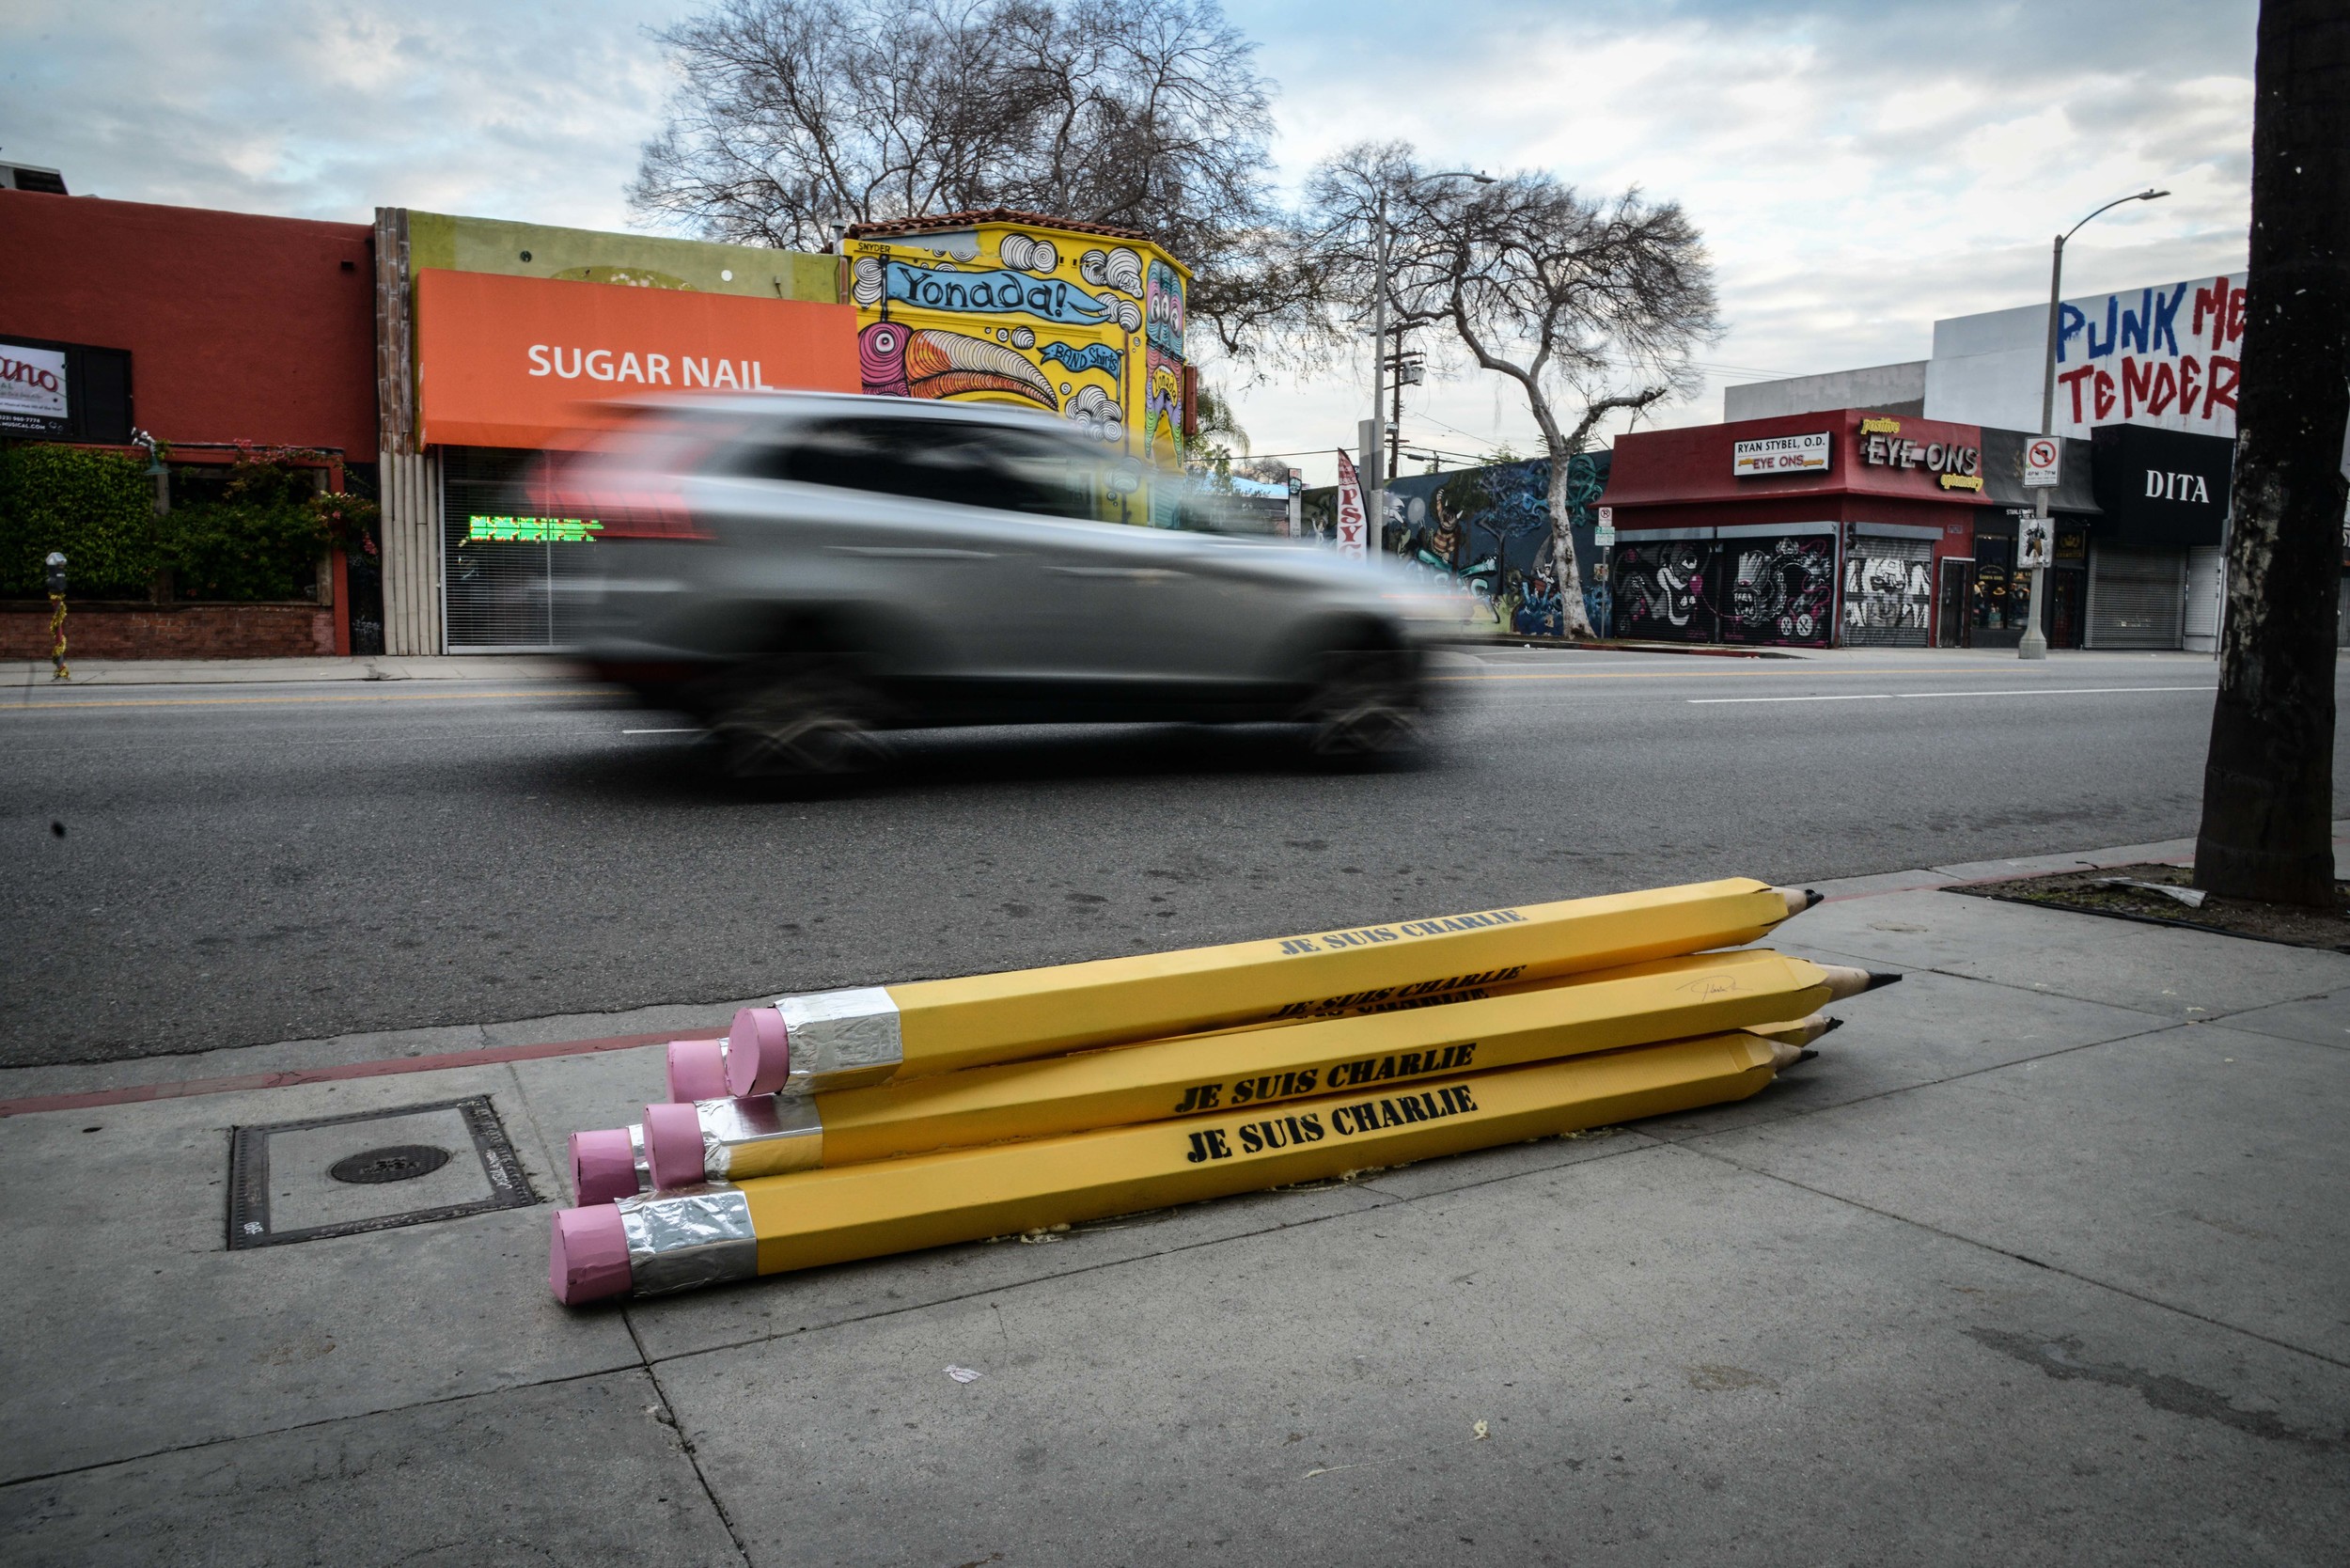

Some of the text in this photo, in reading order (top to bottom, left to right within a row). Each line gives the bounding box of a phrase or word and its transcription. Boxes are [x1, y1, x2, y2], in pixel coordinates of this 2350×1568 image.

[858, 242, 891, 254] SNYDER
[897, 266, 1067, 318] Yonada!
[2057, 276, 2247, 364] PUNK ME
[528, 344, 775, 391] SUGAR NAIL
[1055, 344, 1119, 371] BAND Shirts
[2058, 354, 2241, 424] TENDER
[1737, 436, 1825, 454] RYAN STYBEL, O.D.
[1753, 457, 1776, 469] EYE
[1779, 454, 1805, 467] ONS
[2145, 469, 2211, 504] DITA
[1280, 909, 1529, 956] JE SUIS CHARLIE
[1270, 999, 1315, 1018] JE
[1313, 985, 1398, 1011] SUIS
[1398, 964, 1528, 997] CHARLIE
[1175, 1043, 1477, 1113] JE SUIS CHARLIE
[1186, 1085, 1479, 1163] JE SUIS CHARLIE
